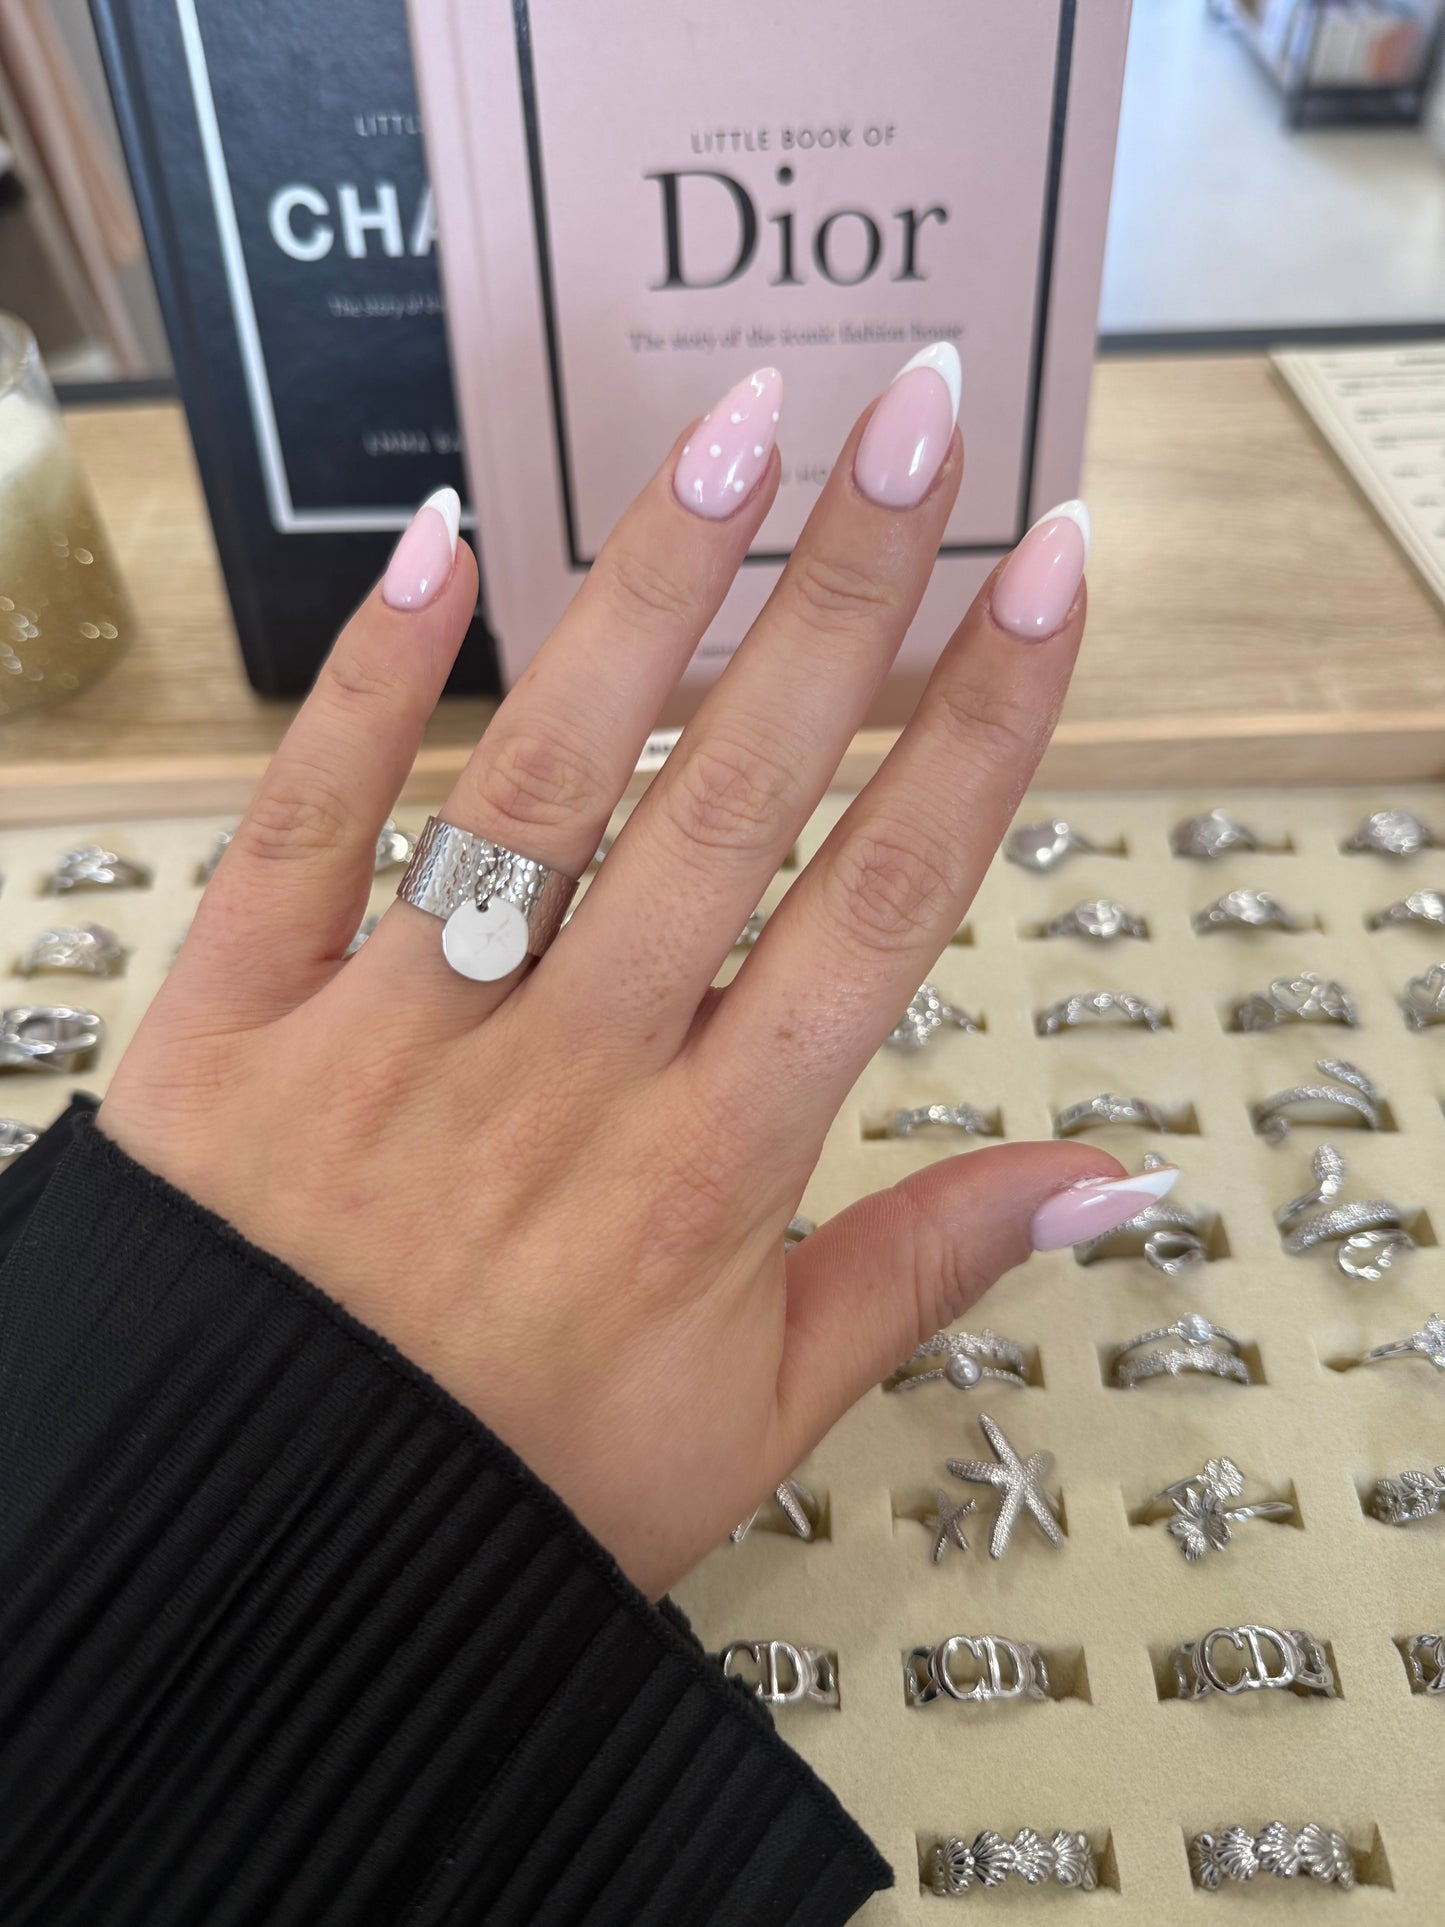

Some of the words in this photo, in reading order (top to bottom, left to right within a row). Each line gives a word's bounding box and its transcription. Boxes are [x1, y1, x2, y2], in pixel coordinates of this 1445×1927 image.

[353, 112, 421, 137] LITTL
[690, 126, 769, 153] LITTLE
[781, 126, 852, 150] BOOK
[863, 124, 896, 148] OF
[643, 164, 949, 292] Dior
